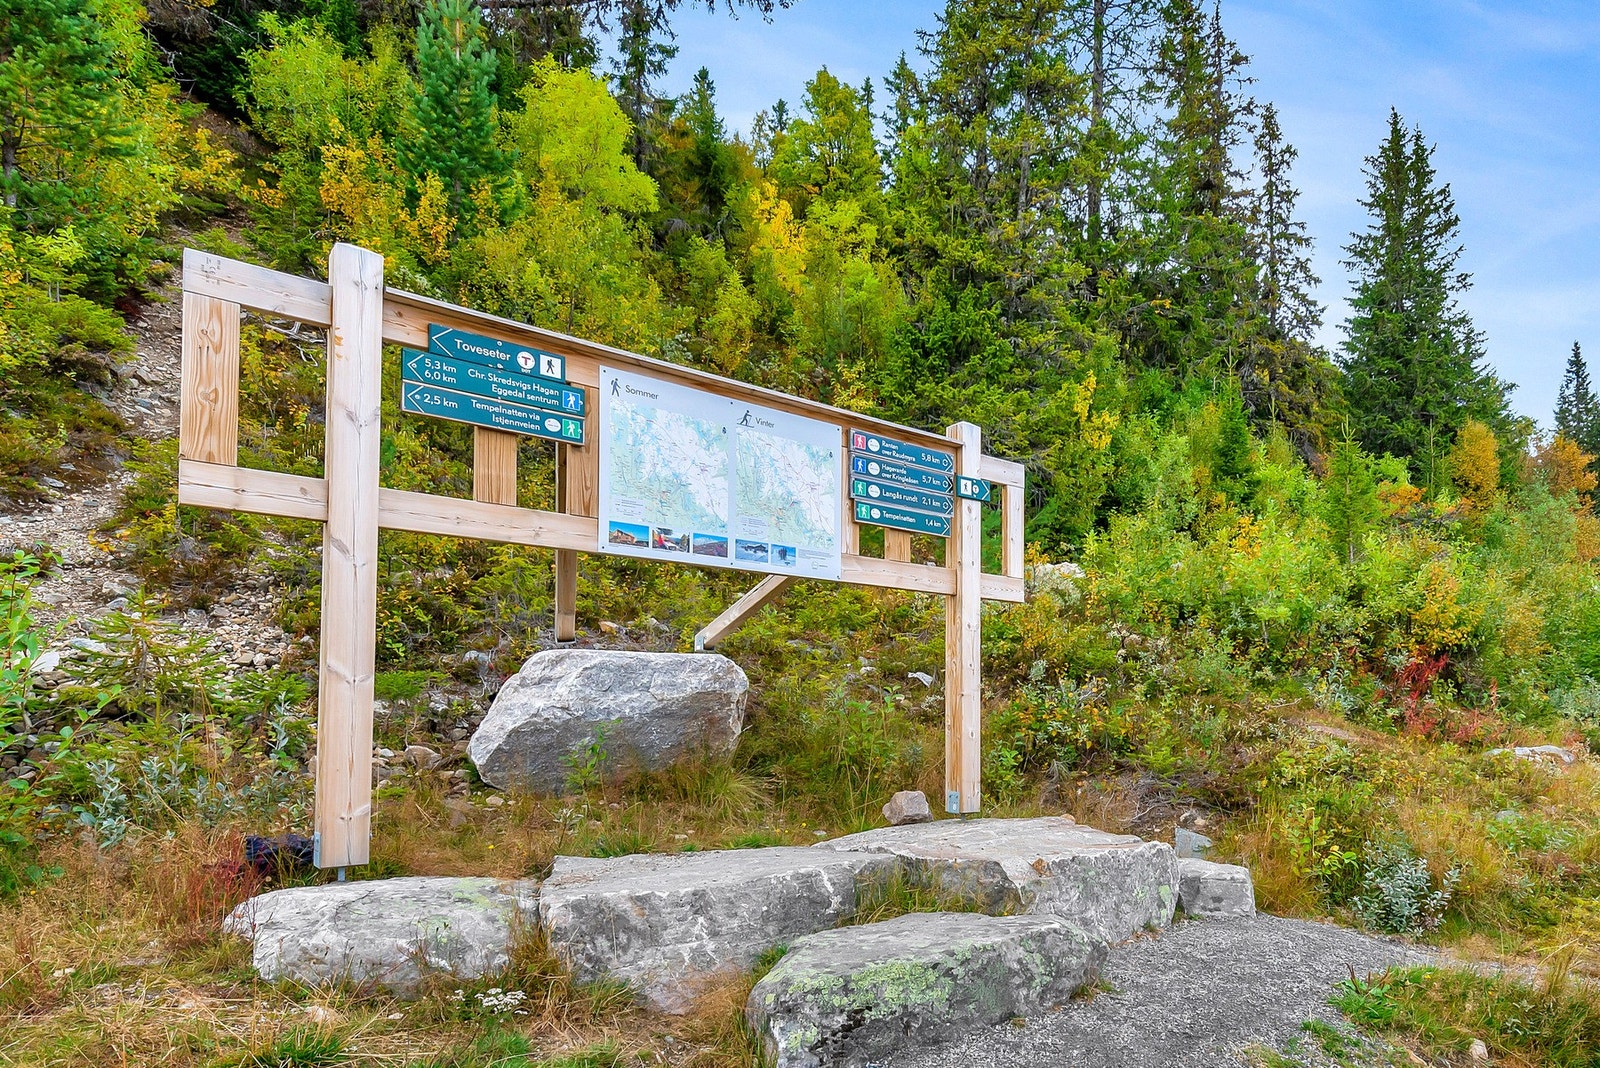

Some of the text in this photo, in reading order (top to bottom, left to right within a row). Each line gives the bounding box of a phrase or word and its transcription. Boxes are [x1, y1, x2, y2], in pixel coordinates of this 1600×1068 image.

[454, 338, 511, 361] Toveseter
[425, 359, 457, 373] 5,3 km
[424, 370, 457, 384] 6,0 km
[468, 368, 560, 397] Chr. Skredsvigs Hagan
[492, 384, 559, 406] Eggedal sentrum
[625, 384, 660, 400] Sommer
[424, 394, 458, 409] 2,5 km
[471, 400, 540, 421] Tempelnatten via
[492, 414, 540, 431] Istjennveien
[755, 416, 776, 428] Vinter
[921, 452, 932, 462] 5,8
[932, 456, 940, 464] km
[922, 476, 932, 484] 5,7
[932, 478, 941, 486] km
[902, 494, 918, 502] rundt
[922, 496, 941, 508] 2,1 km
[882, 510, 916, 524] Tempelnatten
[926, 518, 934, 526] 1,4
